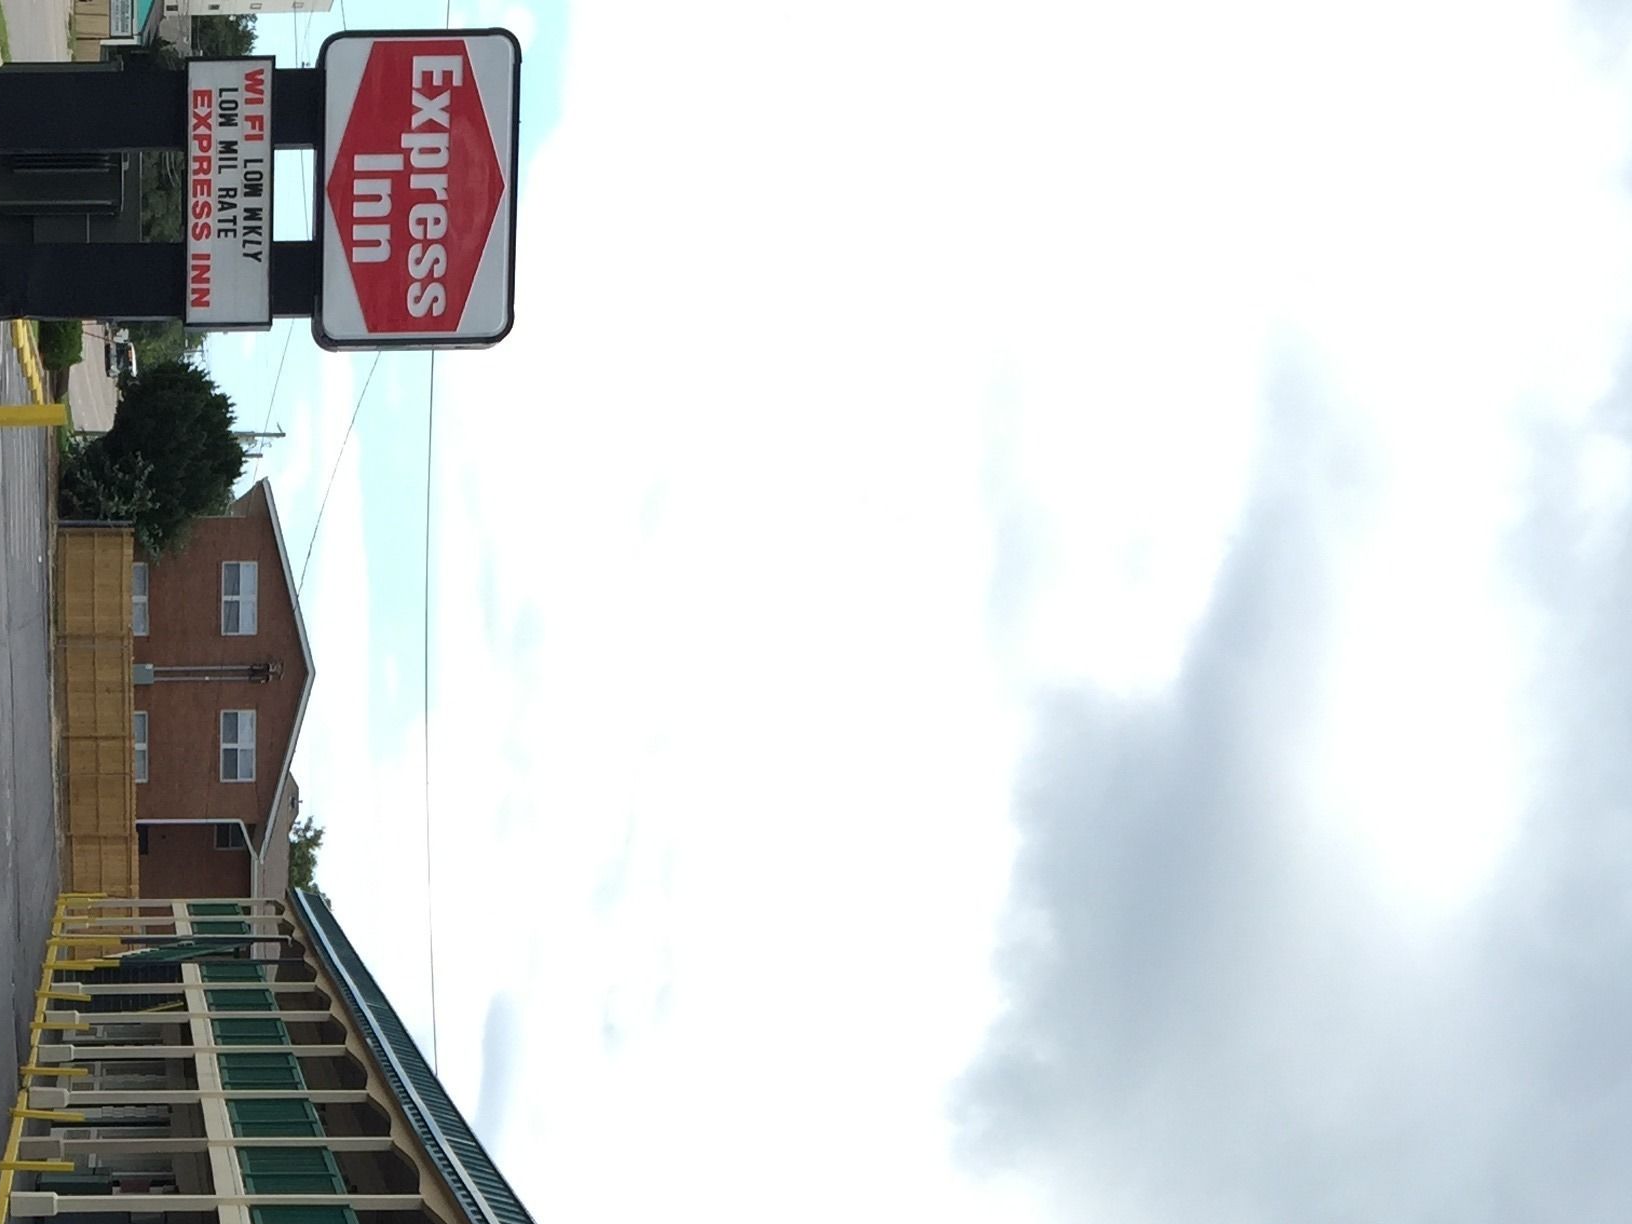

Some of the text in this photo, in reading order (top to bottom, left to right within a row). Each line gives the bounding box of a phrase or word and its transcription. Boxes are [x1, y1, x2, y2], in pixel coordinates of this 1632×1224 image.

[191, 89, 212, 308] EXPRESS INN
[217, 87, 239, 239] LOW MIL RATE
[242, 68, 265, 263] WI FI LOW WKLY
[351, 153, 404, 264] Inn
[400, 54, 464, 318] Express
